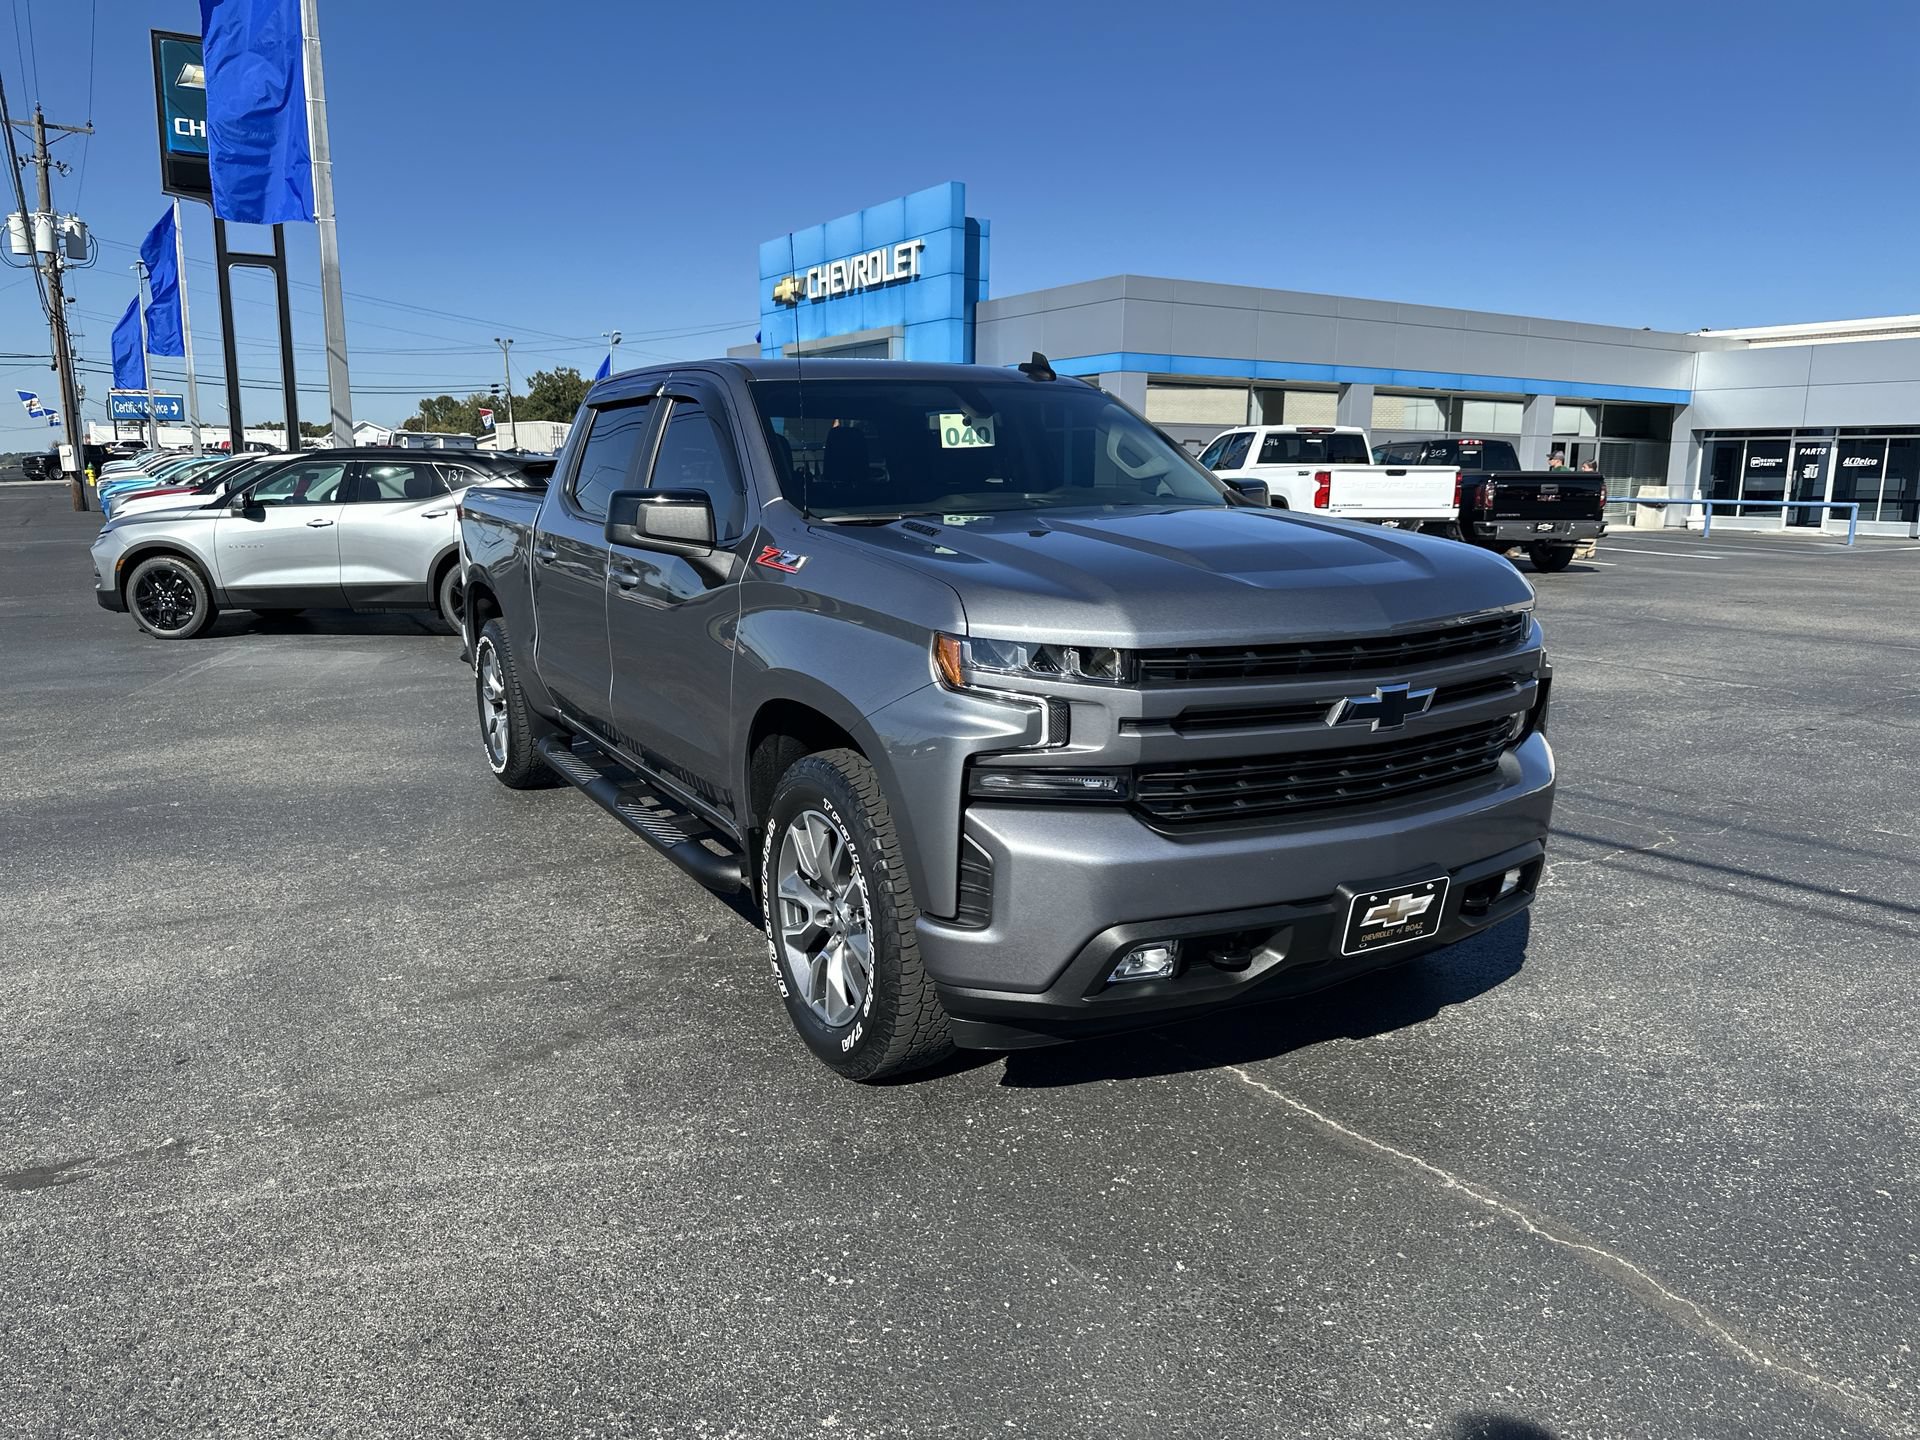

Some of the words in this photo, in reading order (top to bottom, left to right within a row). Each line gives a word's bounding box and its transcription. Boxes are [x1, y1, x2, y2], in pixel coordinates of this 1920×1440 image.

[807, 239, 921, 299] CHEVROLET
[945, 426, 991, 446] 040
[1429, 448, 1448, 458] 303
[1799, 447, 1827, 456] PARTS
[1842, 456, 1878, 467] ACDelco
[447, 469, 465, 482] 137
[755, 545, 809, 574] Z71
[1361, 928, 1394, 942] CHEVROLET
[1404, 921, 1424, 932] BOAZ
[841, 1021, 864, 1053] T/A
